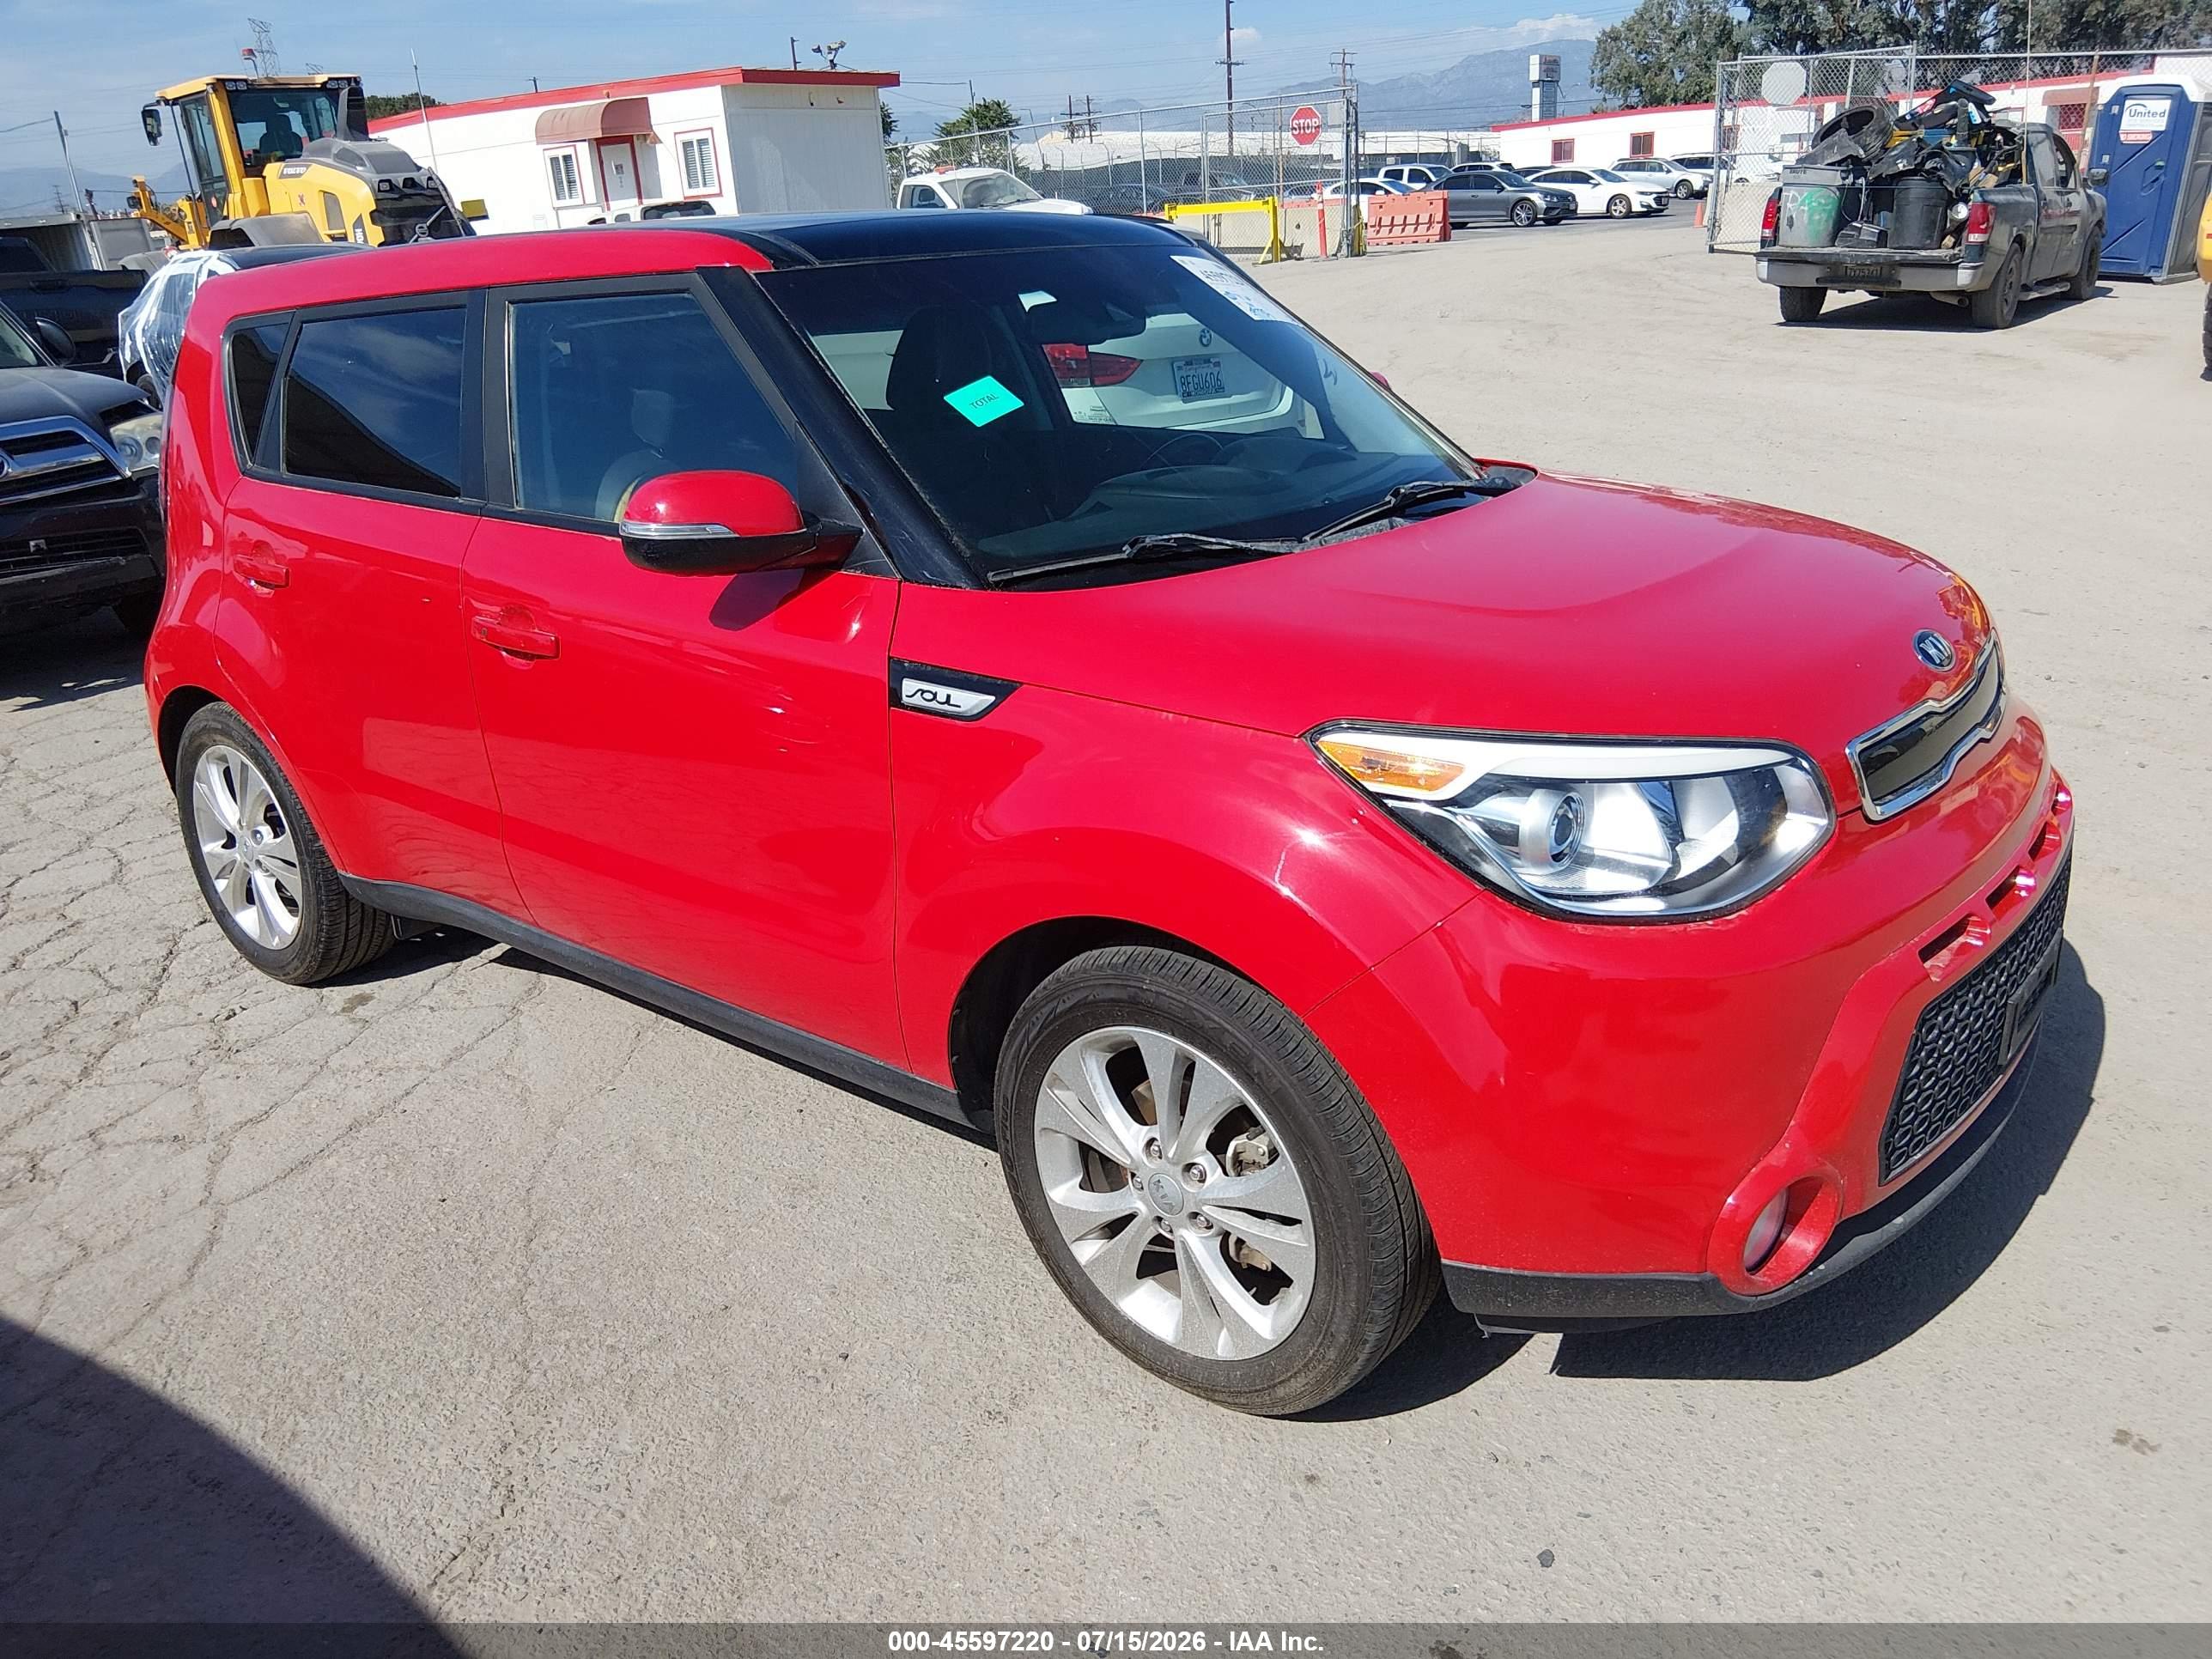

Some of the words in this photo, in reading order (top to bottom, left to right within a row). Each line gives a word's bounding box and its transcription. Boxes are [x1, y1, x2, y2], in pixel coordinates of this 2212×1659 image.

[2129, 108, 2166, 118] United
[1292, 118, 1319, 135] STOP
[1180, 370, 1223, 392] 8FGU606
[969, 392, 1000, 410] TOTAL
